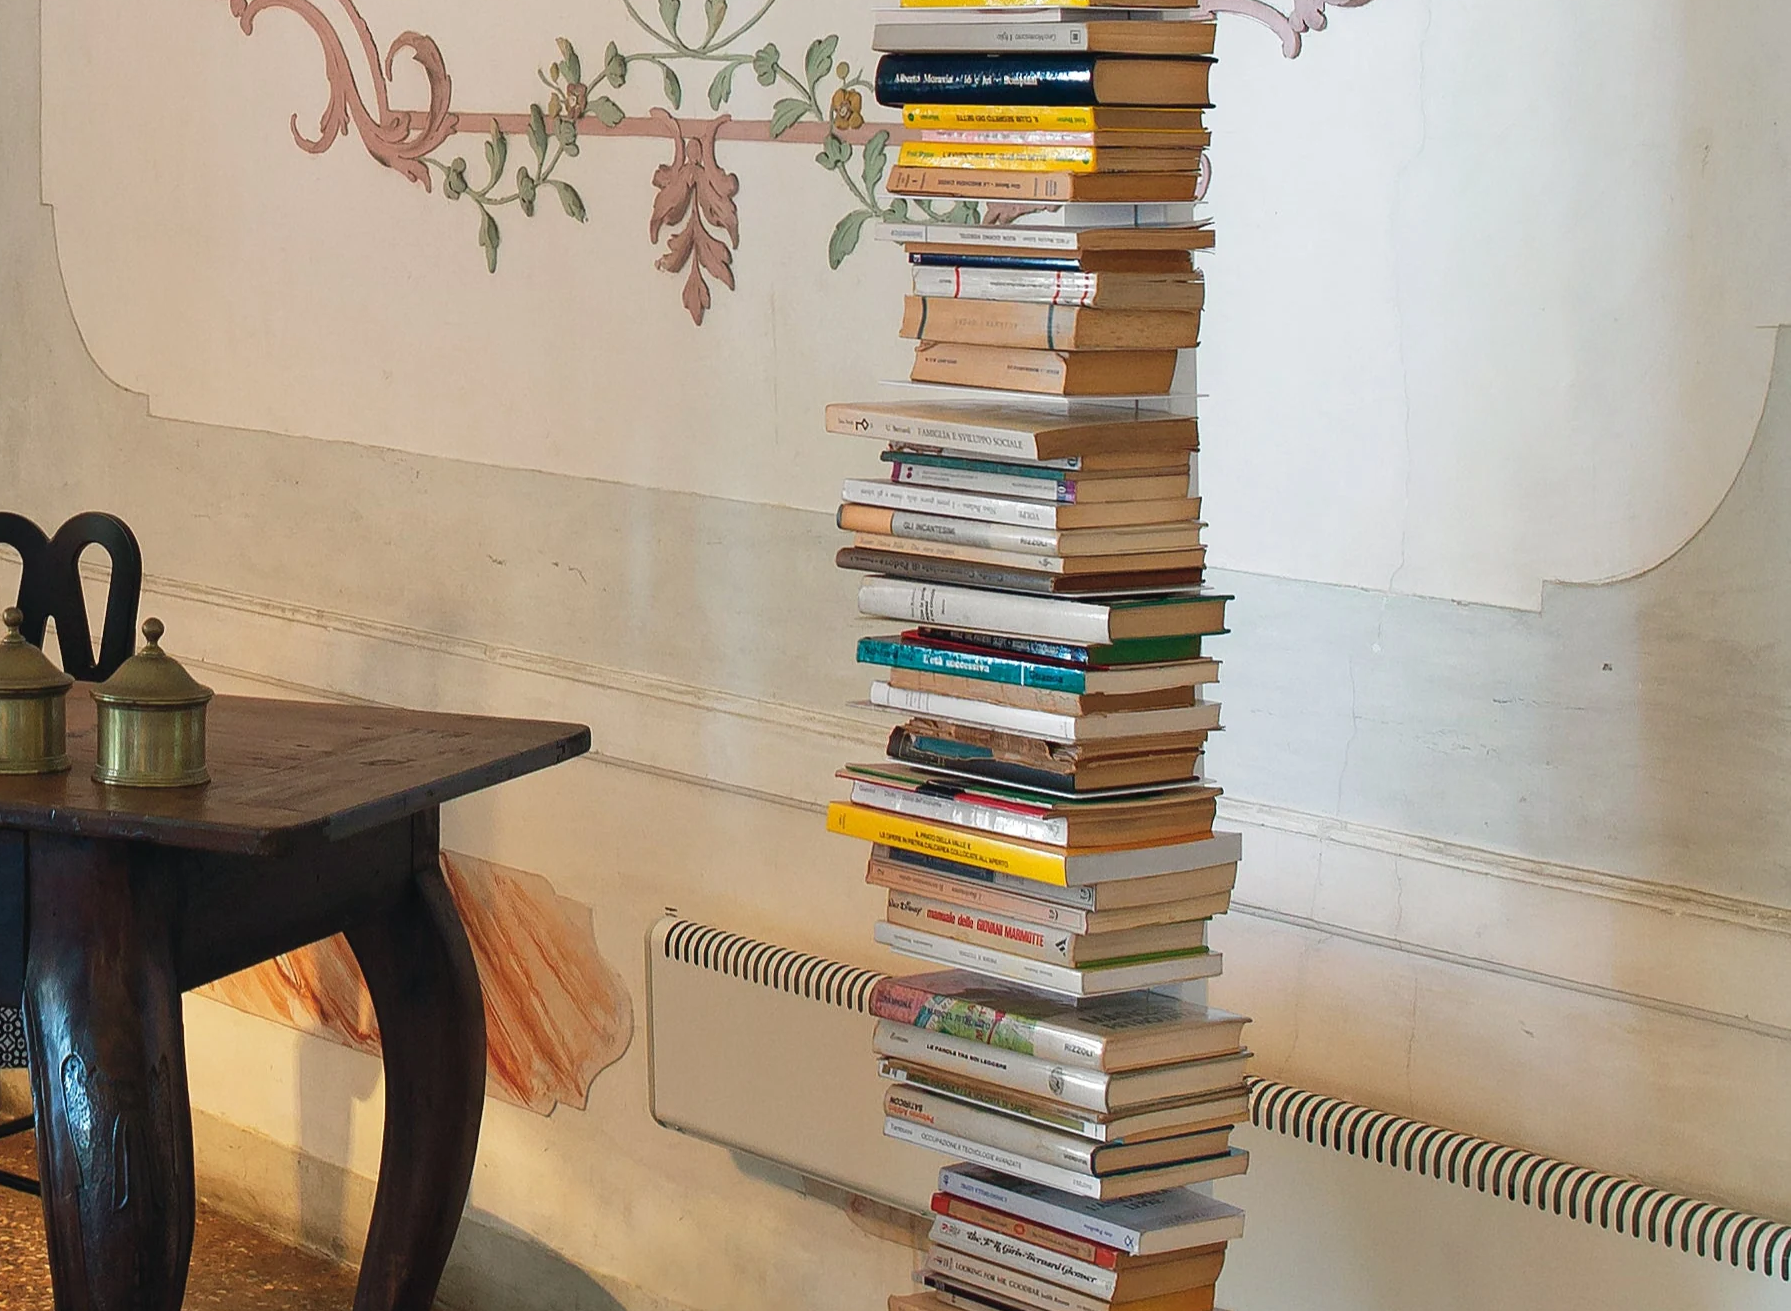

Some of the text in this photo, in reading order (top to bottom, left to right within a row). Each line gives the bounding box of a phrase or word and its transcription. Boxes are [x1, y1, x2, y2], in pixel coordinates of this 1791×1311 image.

[894, 74, 953, 84] Alberto Moravia
[955, 114, 972, 122] SETTE
[987, 115, 1015, 123] SEGRETO
[1016, 115, 1032, 123] CLUB
[918, 427, 950, 440] FAMIGLIA
[958, 433, 991, 445] SVILUPPO
[992, 437, 1023, 449] SOCIALE
[1018, 510, 1040, 521] VOLPE
[923, 655, 990, 673] L'età successiva
[886, 833, 901, 843] OPERE
[924, 842, 948, 853] CALCAREA
[950, 847, 978, 860] COLLOCATE
[920, 831, 934, 841] PRATO
[935, 835, 952, 844] DELLA
[952, 839, 966, 847] VALLE
[926, 909, 956, 924] manuale
[977, 917, 1003, 937] GIOVANI
[1004, 924, 1044, 947] MARMOTTE
[1064, 1043, 1094, 1057] RIZZOLI
[934, 1046, 957, 1058] PAROLE
[958, 1051, 968, 1059] TRA
[969, 1054, 979, 1062] NOI
[980, 1057, 1007, 1071] LEGGERE
[890, 1097, 923, 1112] SATIRICON
[921, 1132, 957, 1150] OCCUPAZIONE
[996, 1155, 1022, 1169] AVANZATE
[955, 1262, 982, 1278] LOOKING
[983, 1272, 996, 1282] FOR
[1009, 1279, 1040, 1296] GOODBAR
